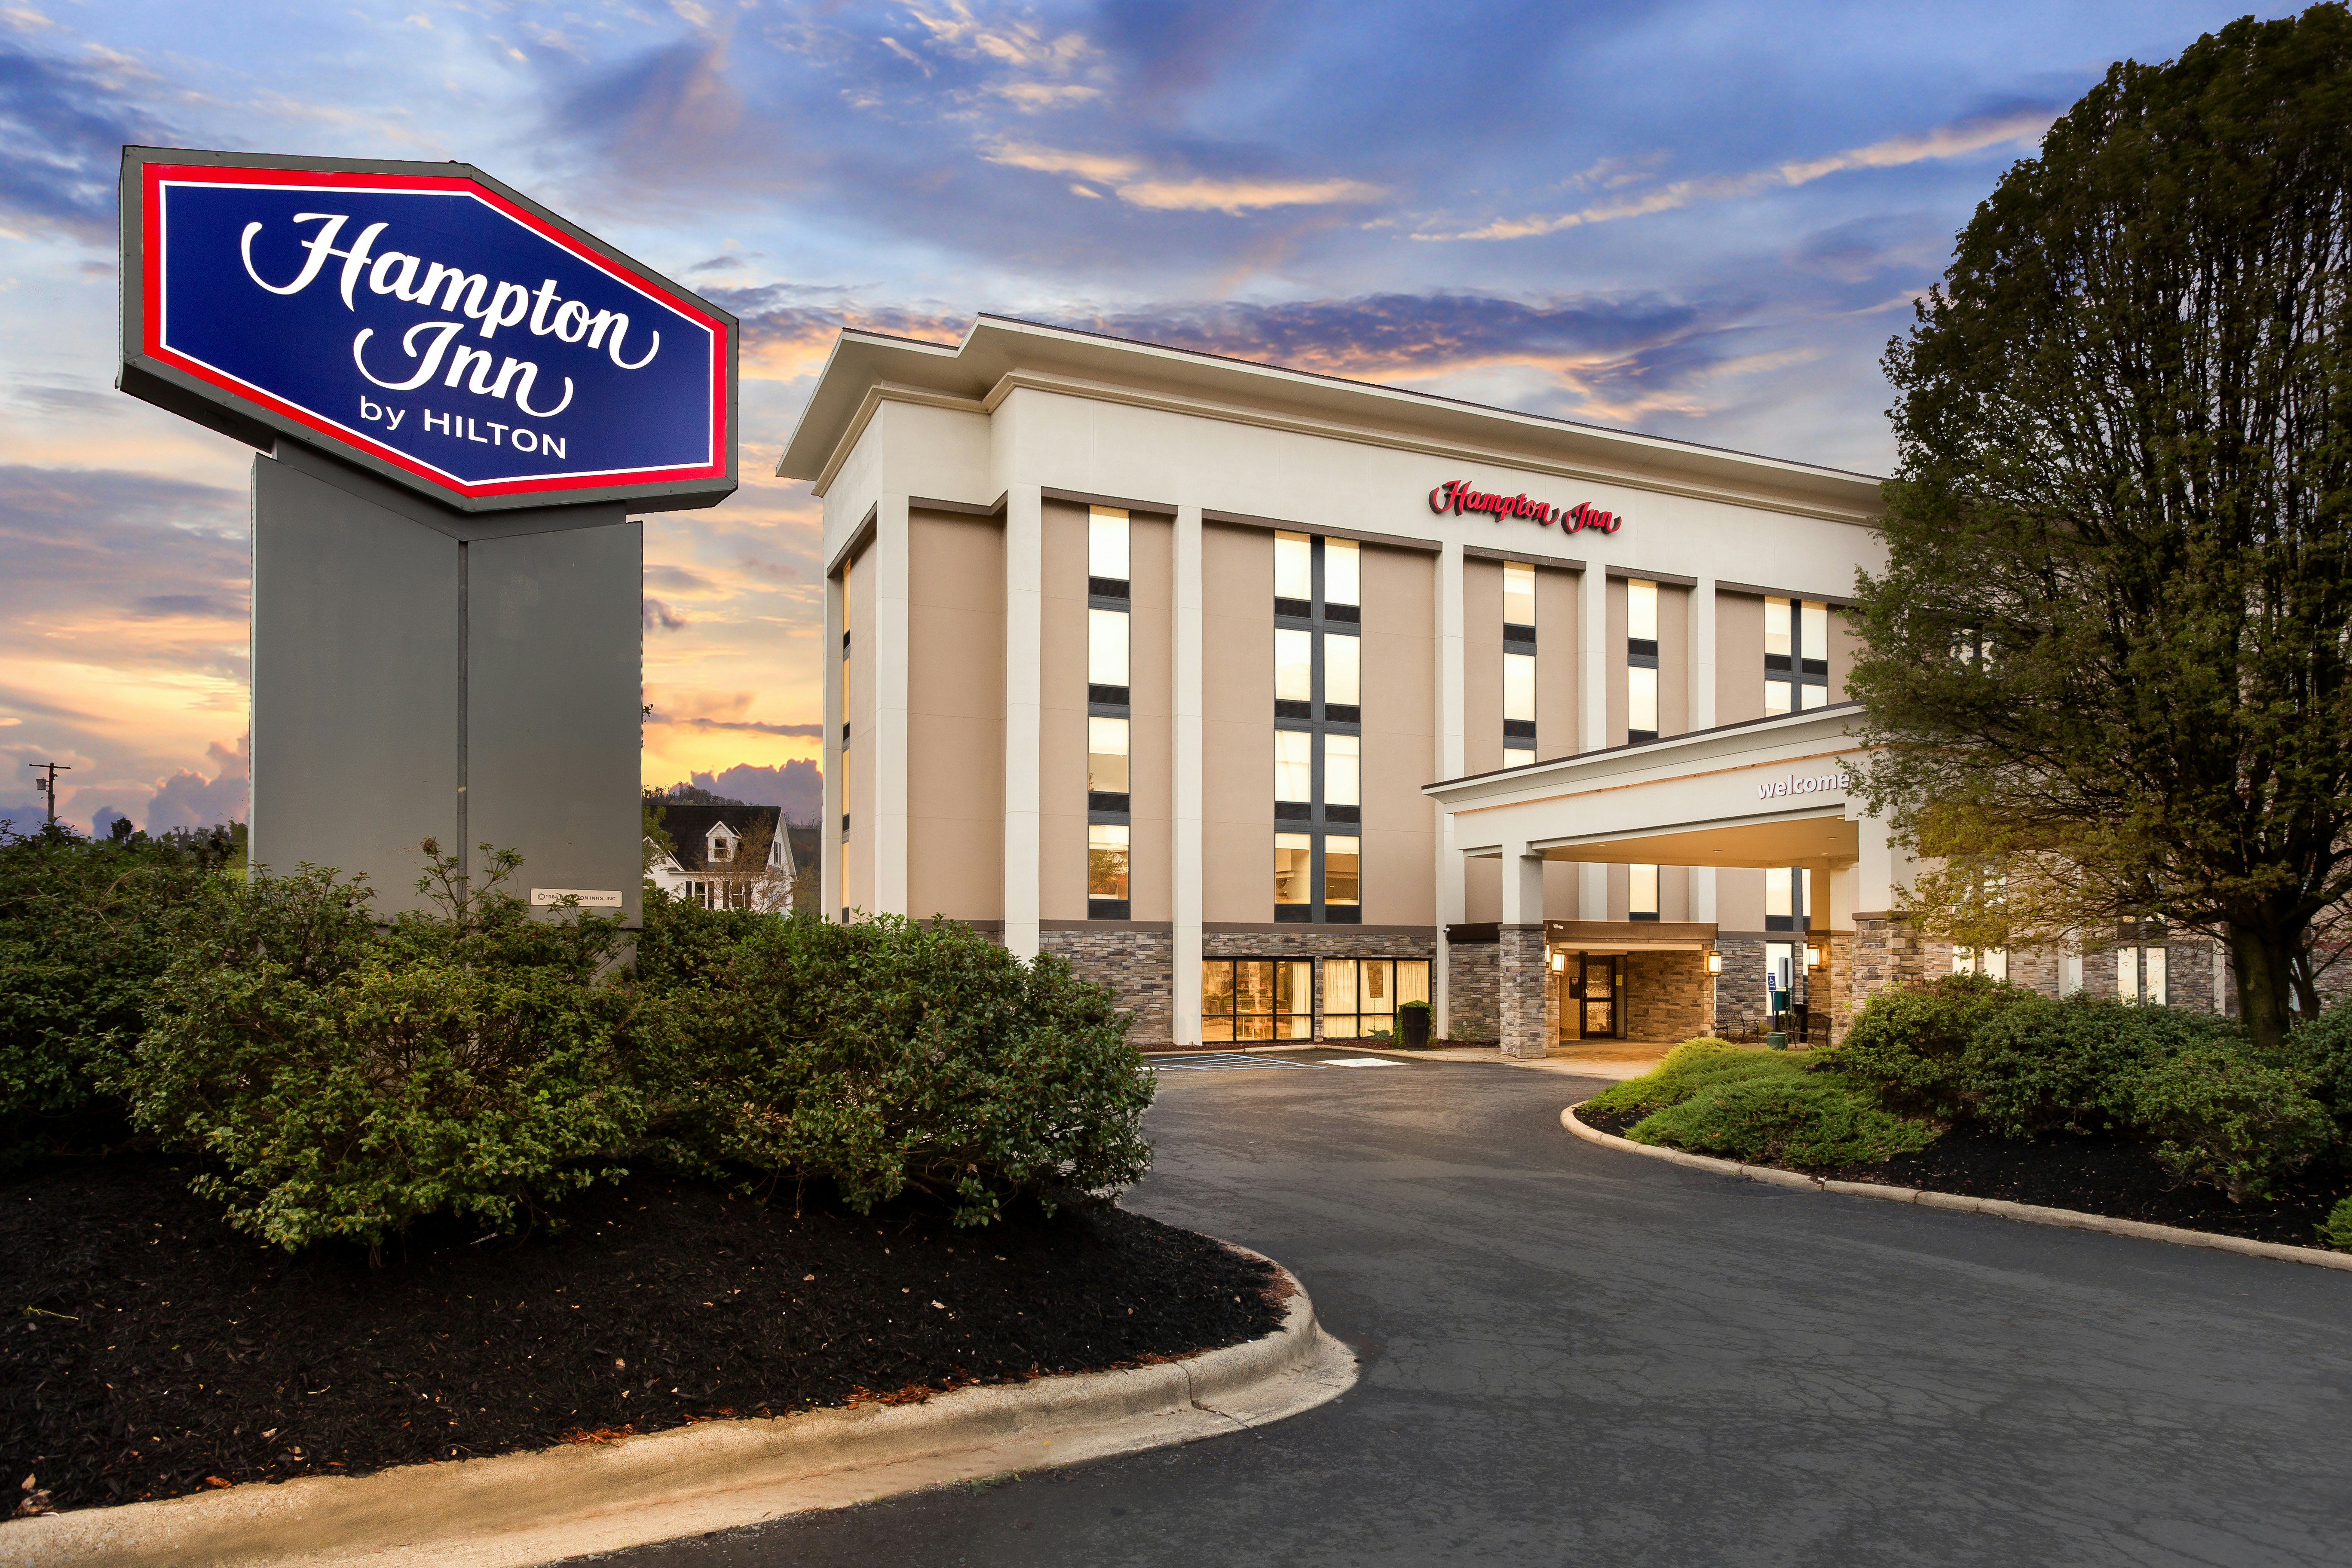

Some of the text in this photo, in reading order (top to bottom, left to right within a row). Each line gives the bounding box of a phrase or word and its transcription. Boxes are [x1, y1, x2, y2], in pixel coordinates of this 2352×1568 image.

[241, 212, 660, 370] Hampton
[353, 321, 574, 418] Inn
[360, 395, 566, 459] by HILTON
[1429, 480, 1622, 533] Hampton Inn
[1757, 773, 1850, 799] welcome
